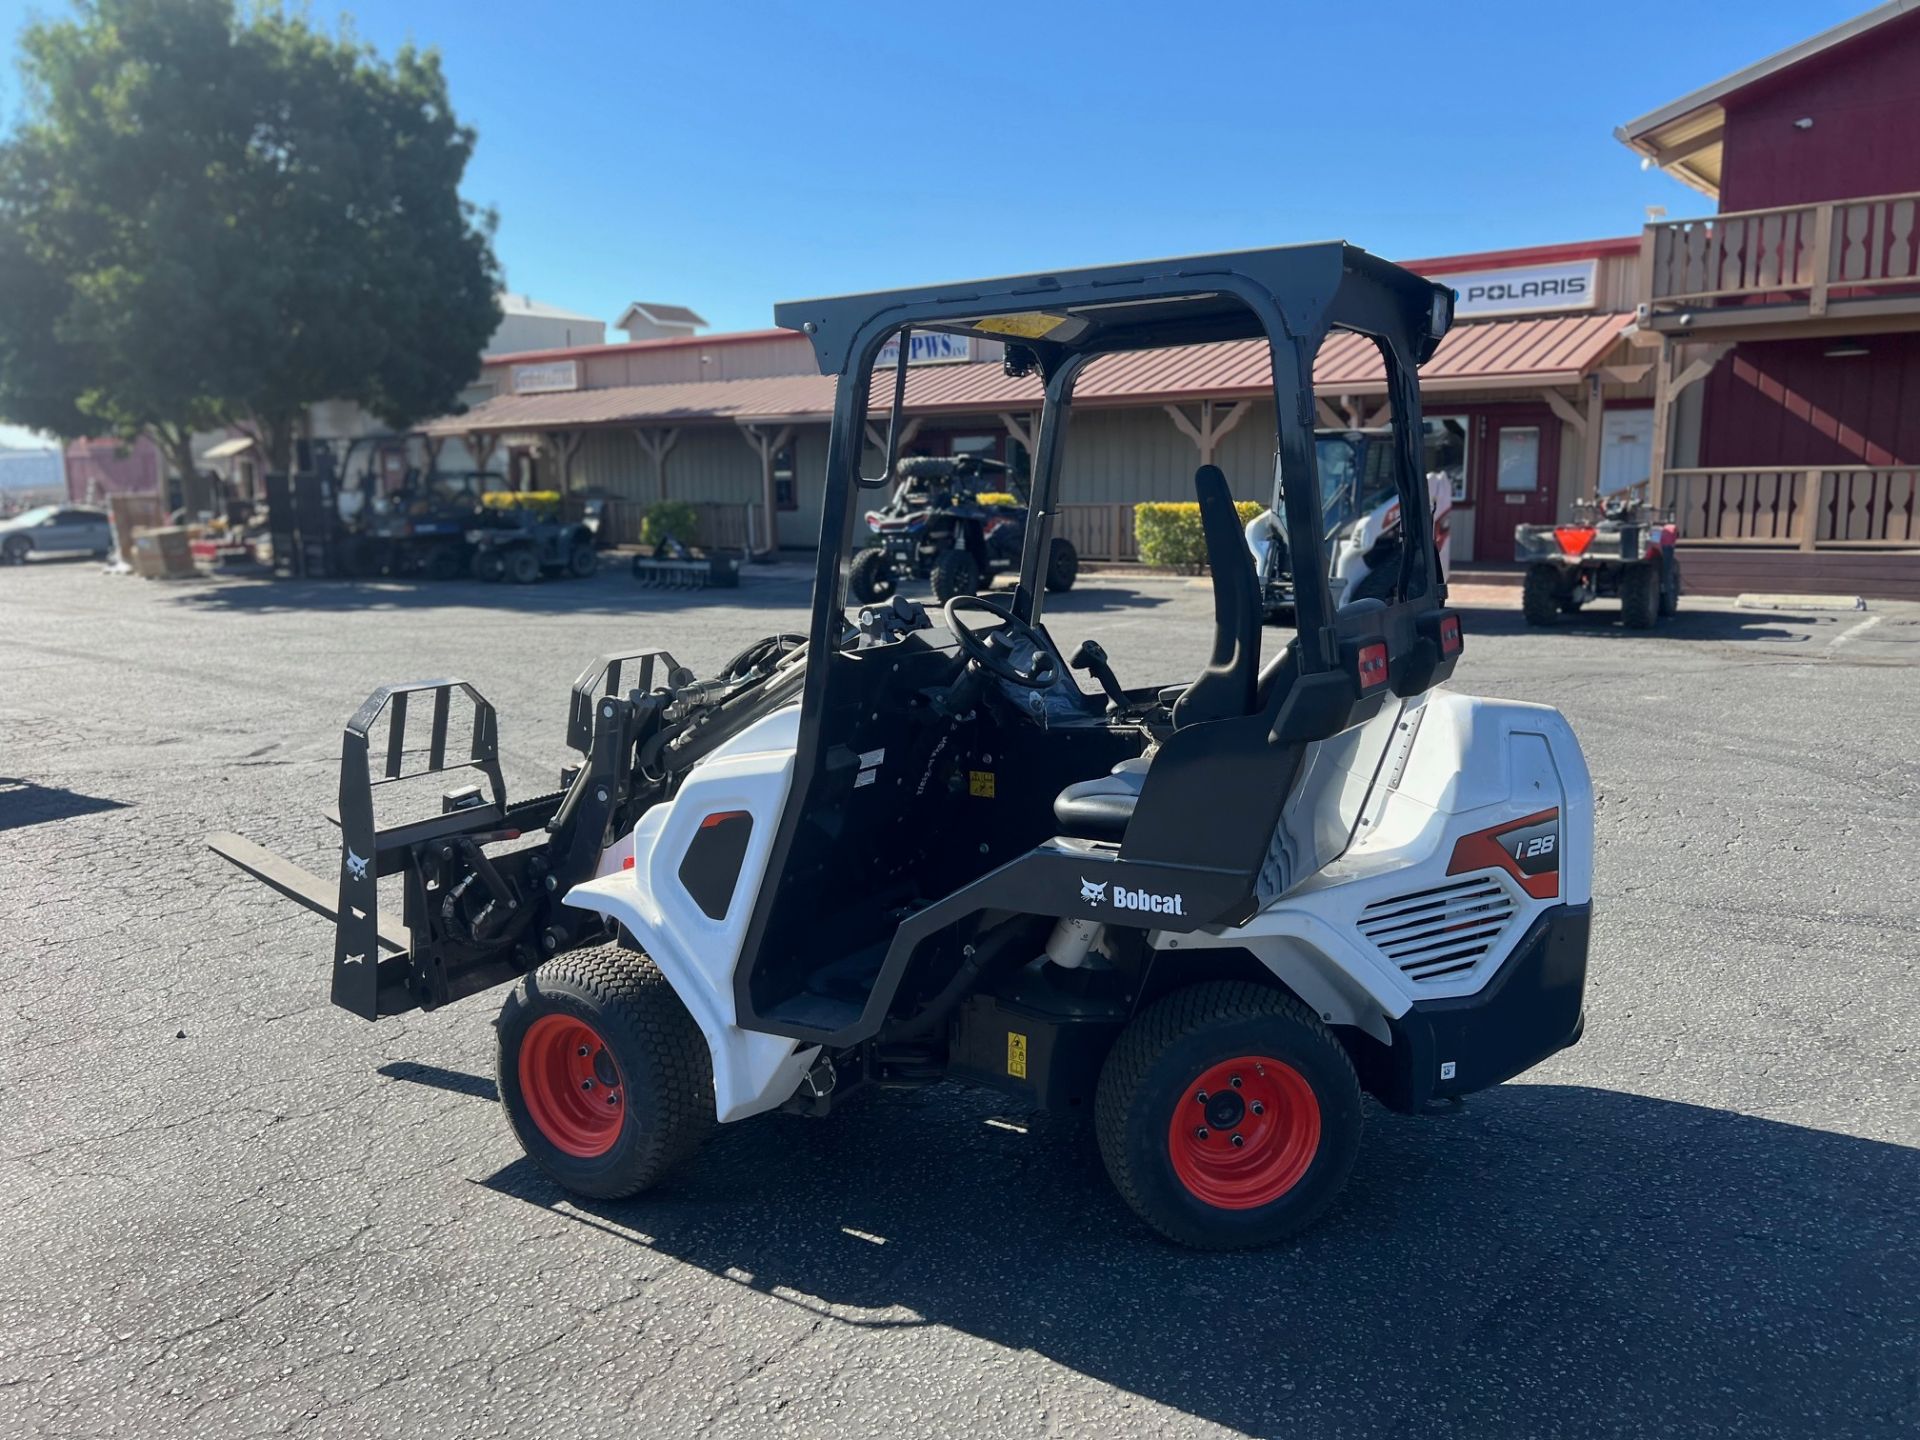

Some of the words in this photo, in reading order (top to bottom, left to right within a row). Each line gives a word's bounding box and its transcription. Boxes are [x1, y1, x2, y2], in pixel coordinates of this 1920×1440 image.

[1468, 277, 1586, 302] POLARIS
[911, 334, 952, 359] PWS
[1113, 886, 1183, 915] Bobcat
